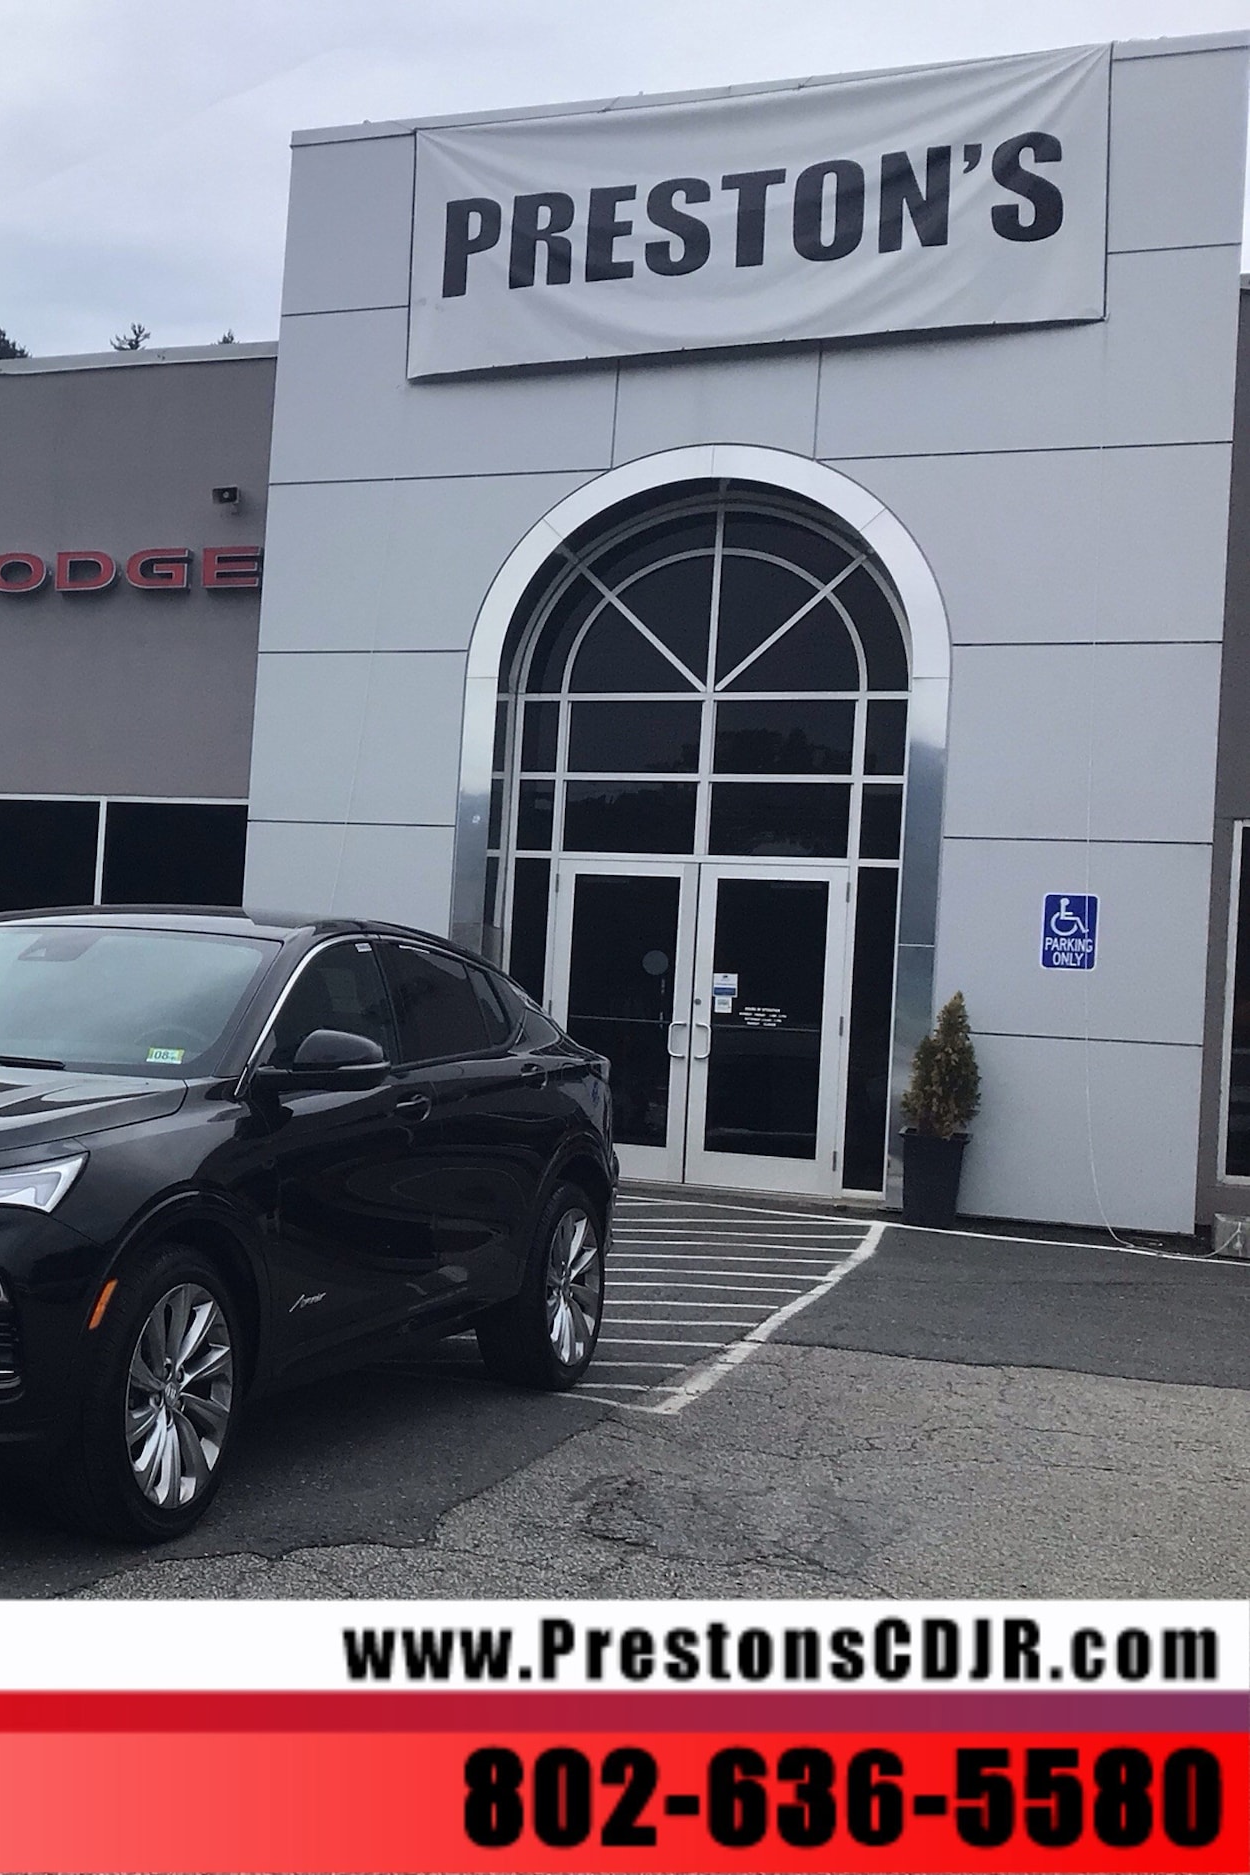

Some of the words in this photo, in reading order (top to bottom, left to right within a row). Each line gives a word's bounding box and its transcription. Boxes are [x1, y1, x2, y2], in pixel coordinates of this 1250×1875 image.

[441, 131, 1064, 298] PRESTON'S
[1044, 937, 1094, 953] PARKING
[1052, 951, 1084, 966] ONLY
